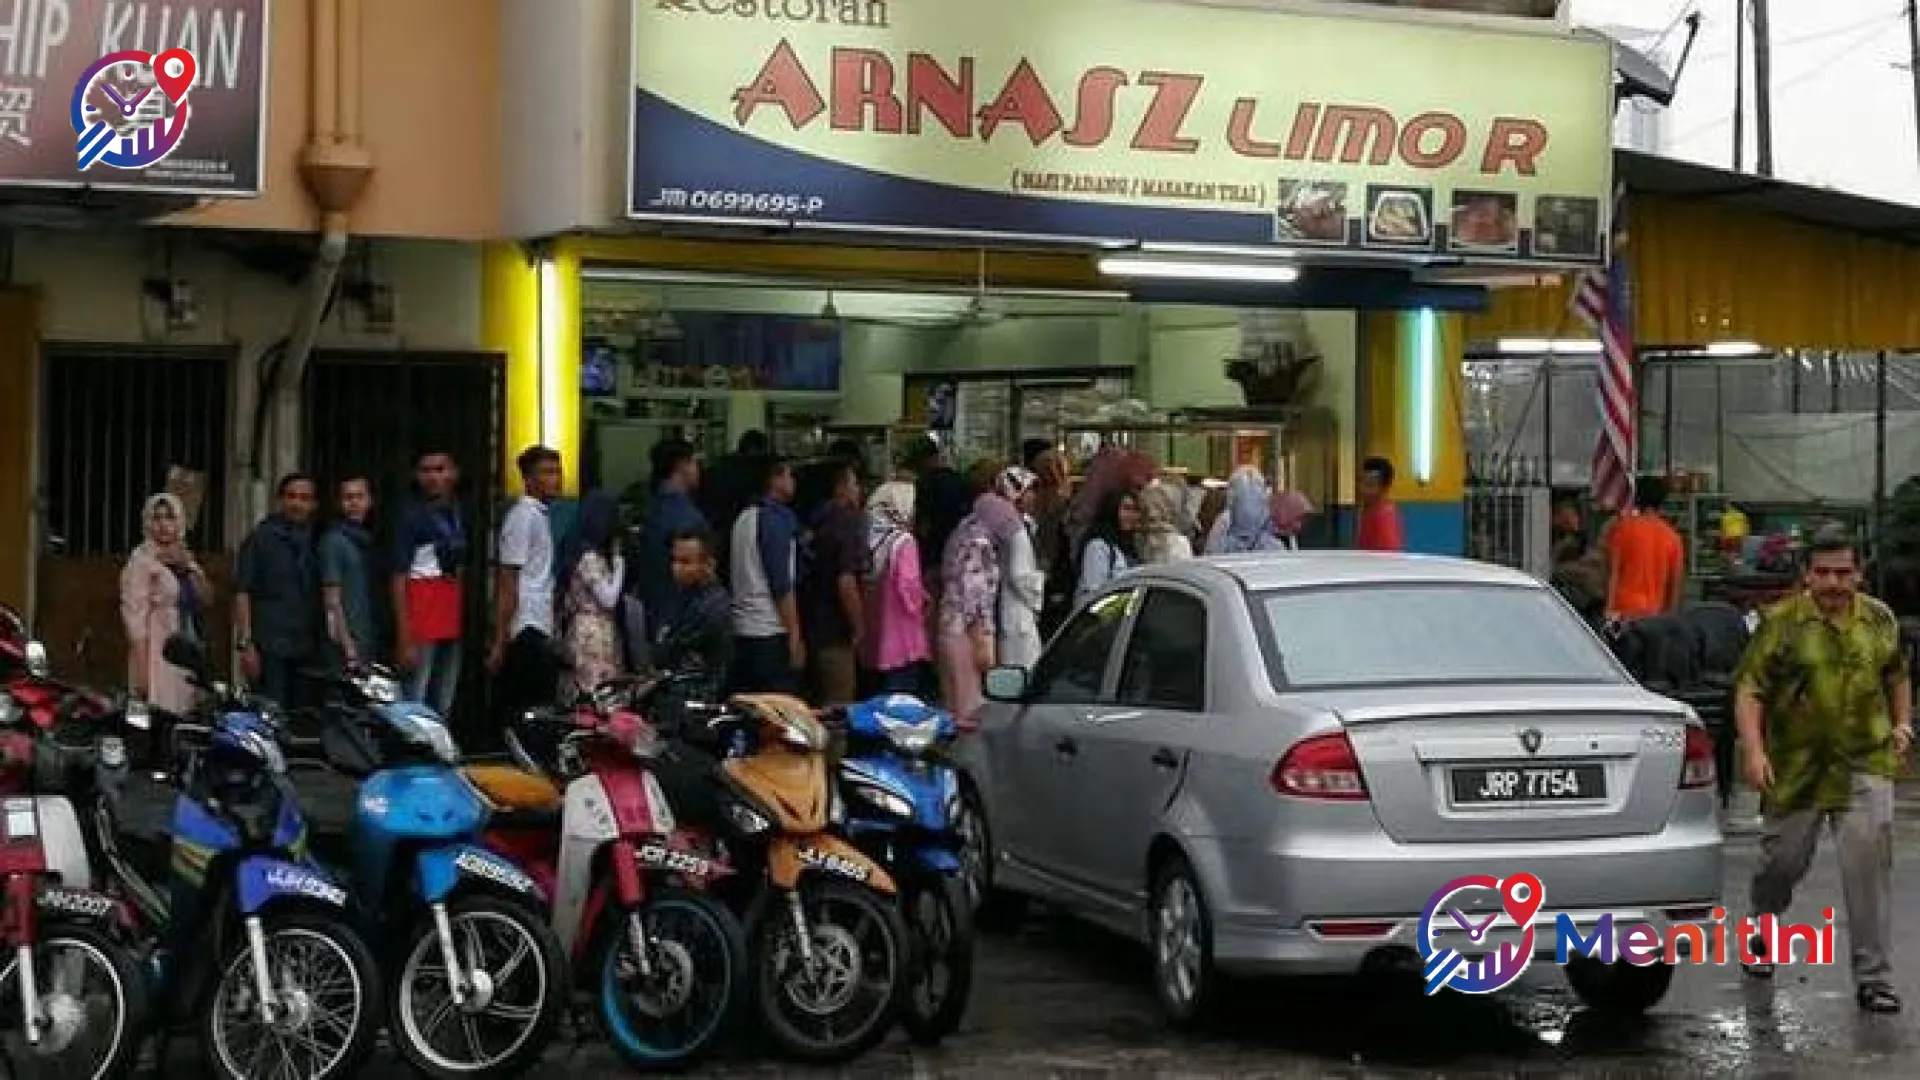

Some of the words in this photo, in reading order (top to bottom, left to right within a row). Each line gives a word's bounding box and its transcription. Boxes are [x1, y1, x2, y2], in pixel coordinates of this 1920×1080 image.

[731, 37, 1206, 152] ARNASZ
[1480, 771, 1519, 796] JRP
[1523, 769, 1580, 796] 7754
